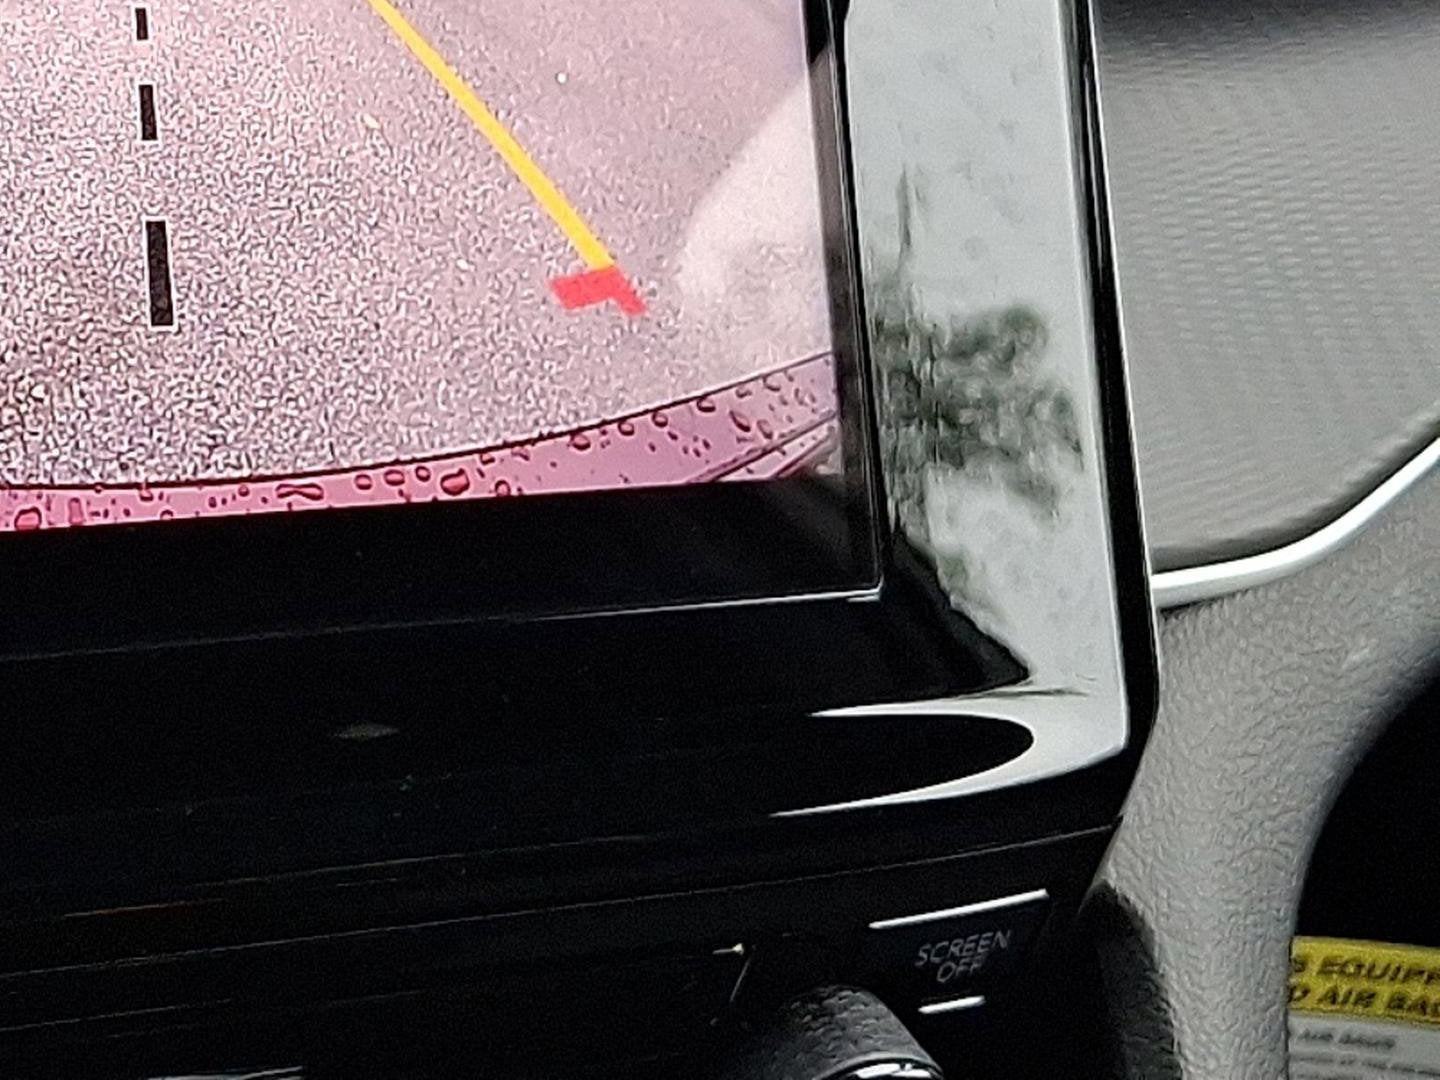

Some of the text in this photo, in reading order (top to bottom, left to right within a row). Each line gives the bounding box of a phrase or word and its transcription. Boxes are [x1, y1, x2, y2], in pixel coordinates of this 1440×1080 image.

[914, 929, 1011, 967] SCREEN
[936, 955, 987, 984] OFF
[1317, 984, 1378, 1008] AIR
